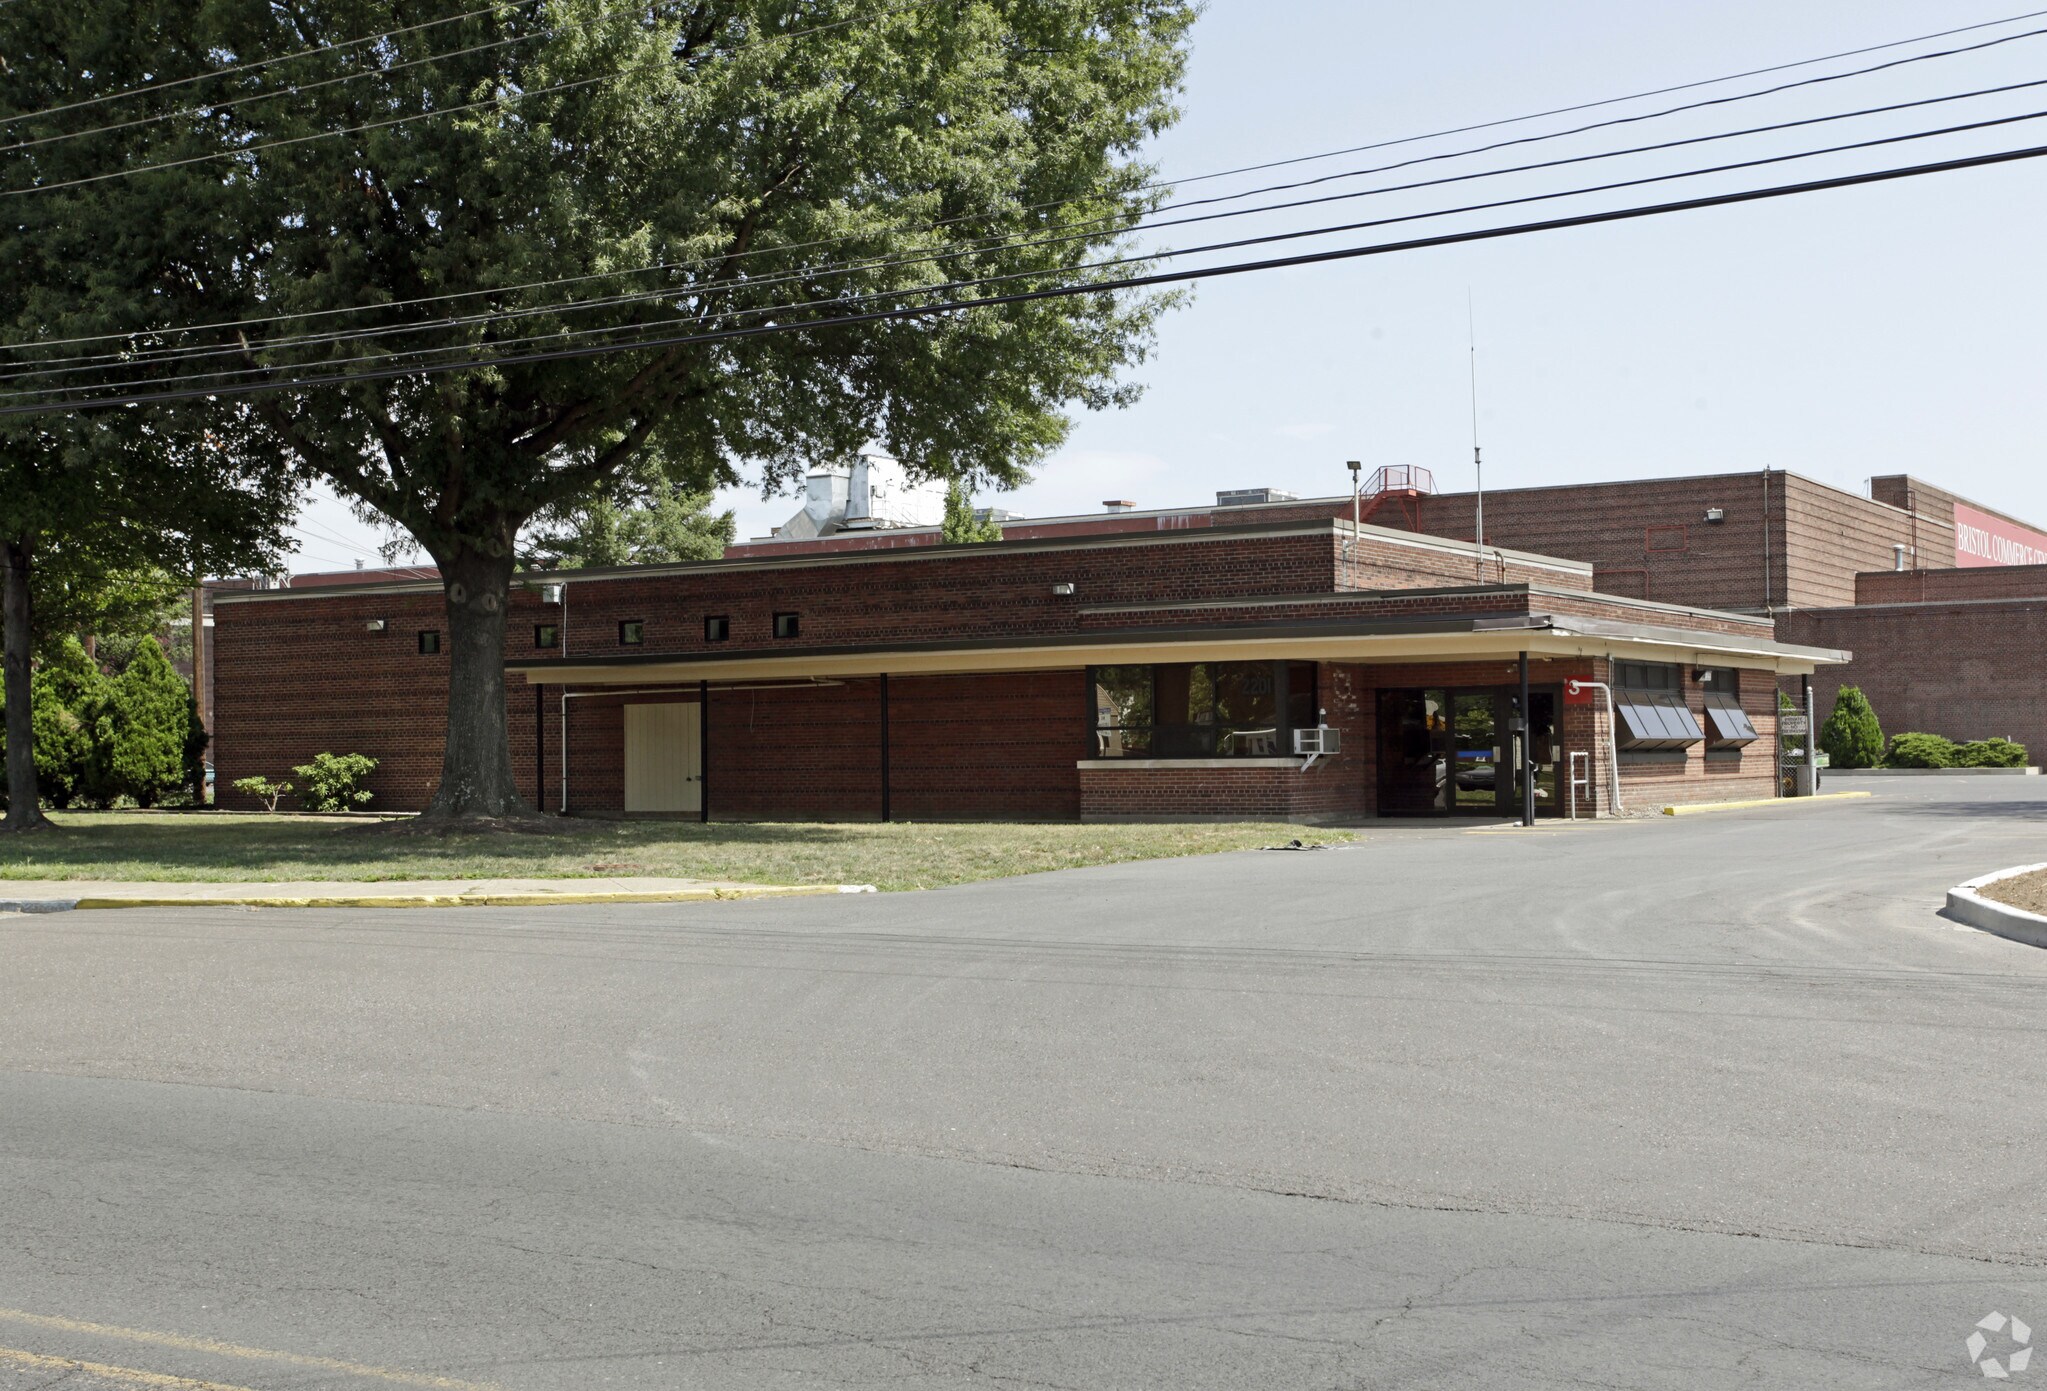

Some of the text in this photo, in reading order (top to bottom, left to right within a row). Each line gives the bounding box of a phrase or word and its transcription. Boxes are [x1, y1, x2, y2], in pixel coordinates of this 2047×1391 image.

[1957, 522, 1991, 559] BRISTOL
[1992, 534, 2033, 565] COMMERCE
[1243, 677, 1271, 694] 2201
[1569, 679, 1580, 695] 3
